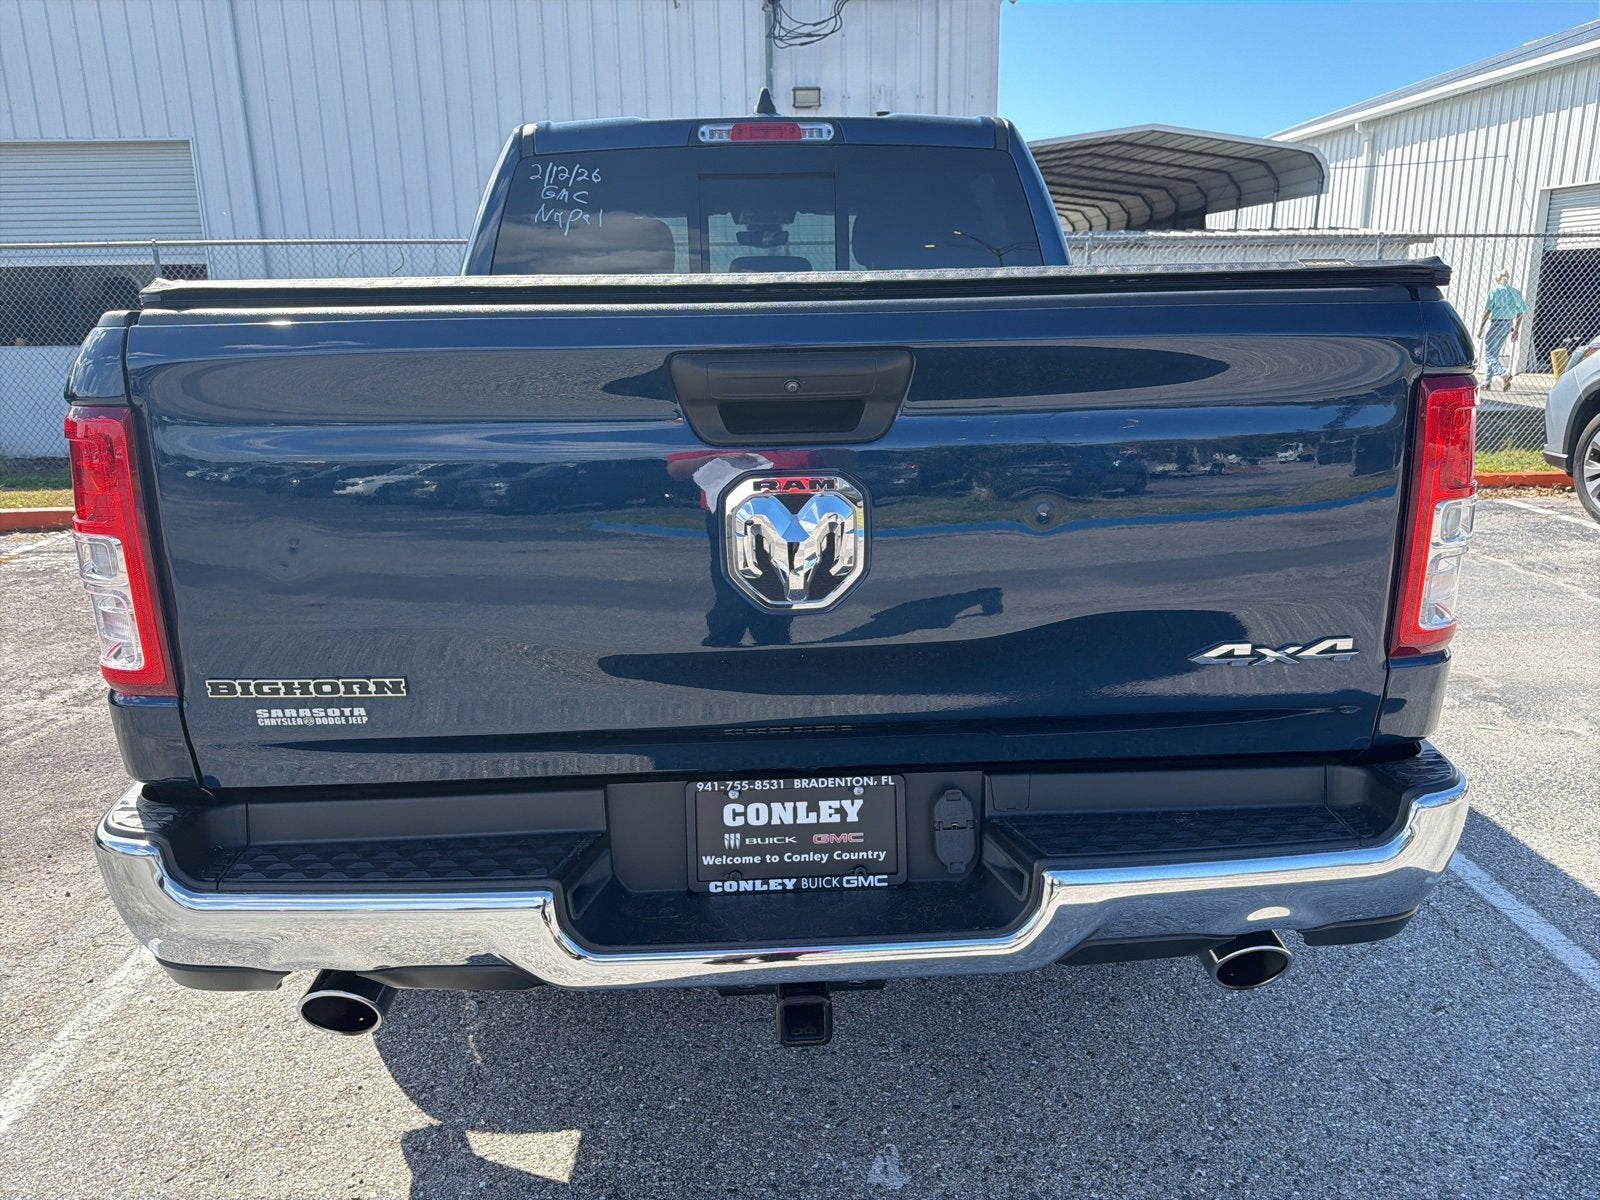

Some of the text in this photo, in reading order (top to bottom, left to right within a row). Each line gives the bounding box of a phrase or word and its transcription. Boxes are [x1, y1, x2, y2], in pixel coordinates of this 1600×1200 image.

[529, 162, 602, 187] 2/12/26
[541, 186, 589, 204] GMC
[753, 479, 835, 492] RAM
[255, 707, 367, 717] SARASOTA
[257, 716, 369, 726] CHRYSLER DODGE JEEP
[696, 775, 895, 792] 941-755-8531 BRADENTON, FL
[722, 799, 864, 827] CONLEY
[745, 836, 798, 845] BUICK
[812, 832, 865, 844] GMC
[702, 850, 887, 865] Welcome to Conley Country
[708, 875, 889, 893] CONLEY BUICK GMC
